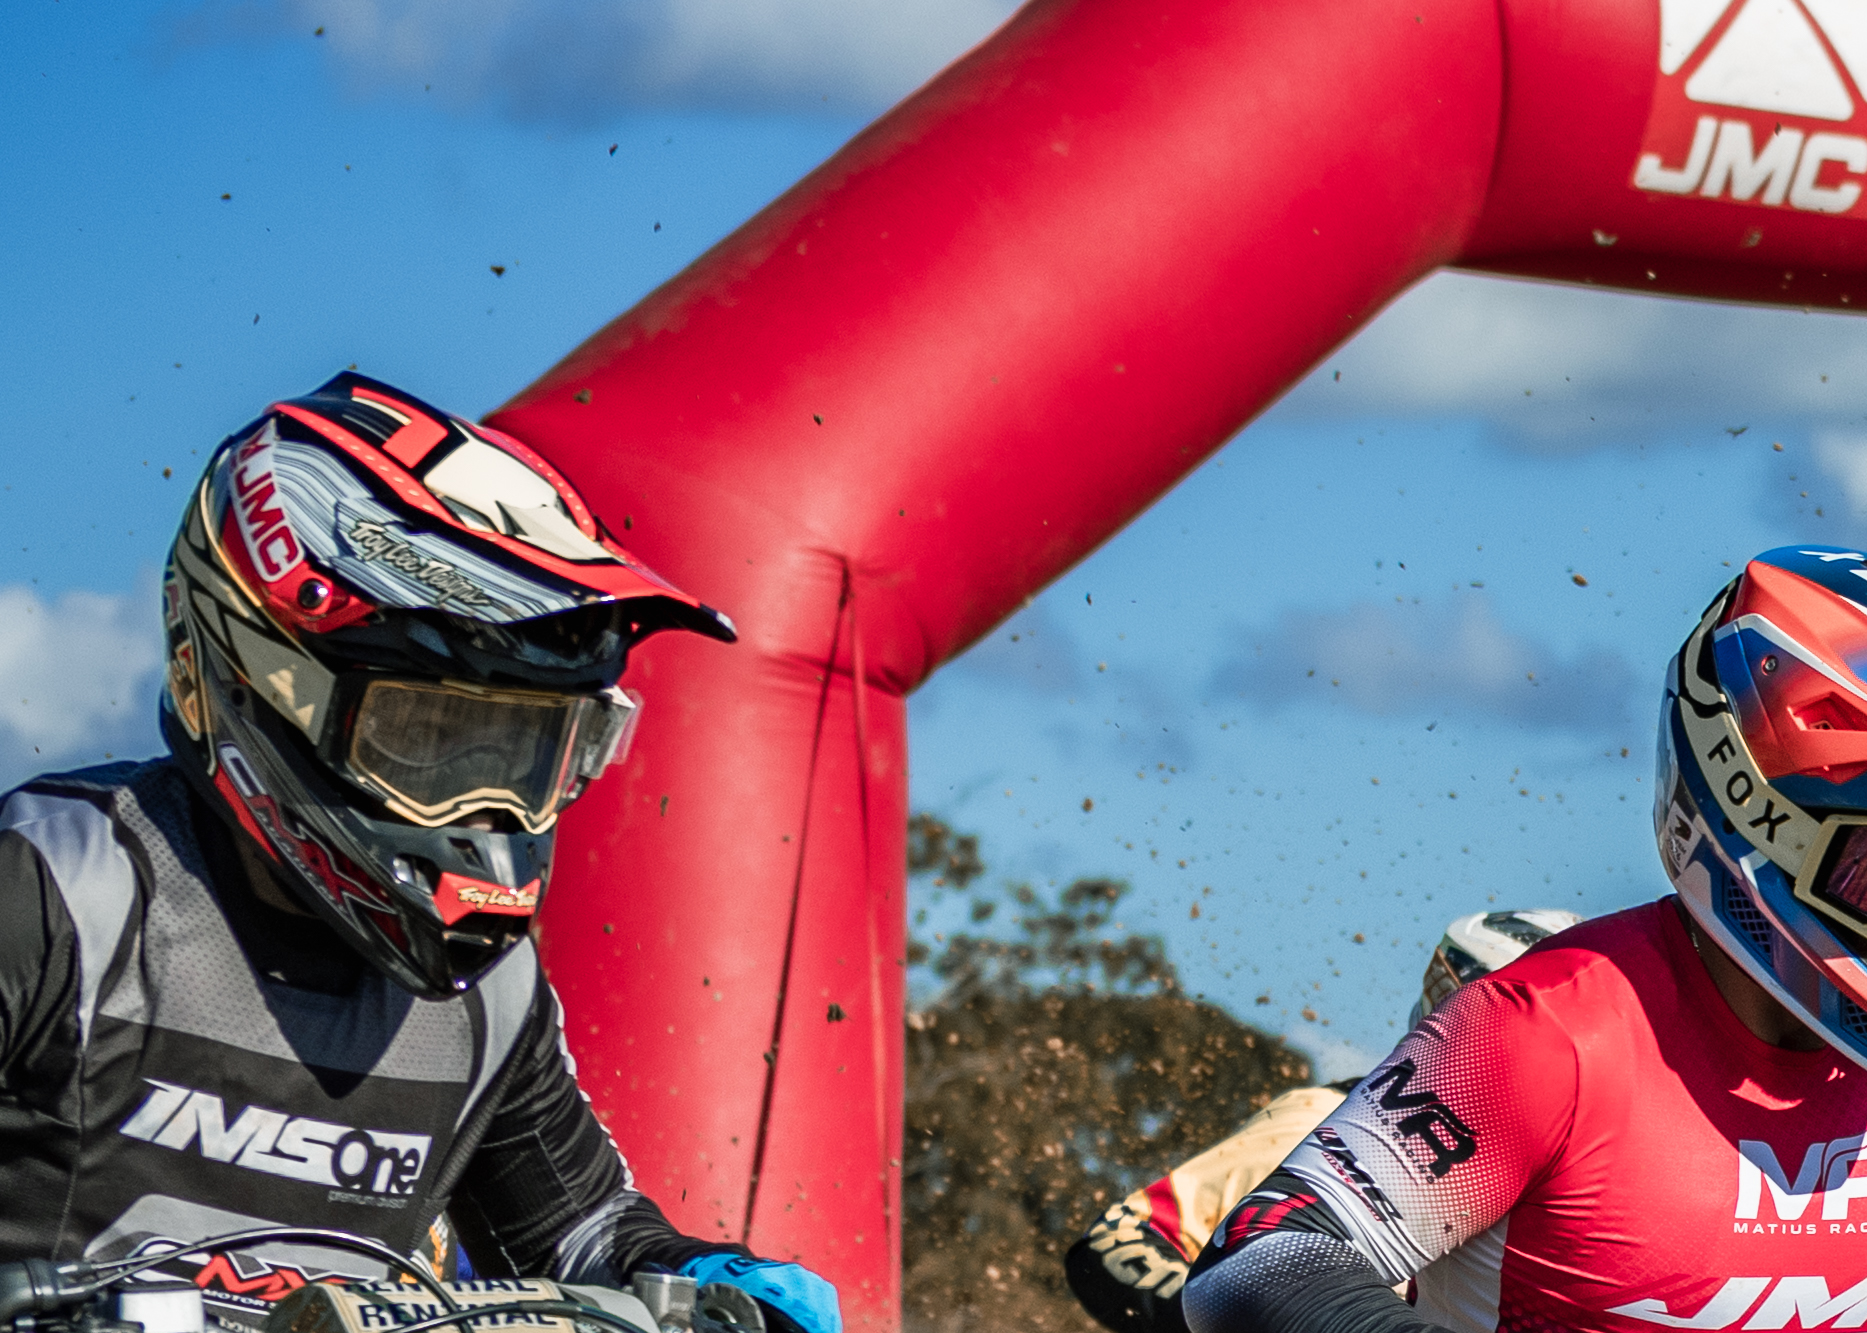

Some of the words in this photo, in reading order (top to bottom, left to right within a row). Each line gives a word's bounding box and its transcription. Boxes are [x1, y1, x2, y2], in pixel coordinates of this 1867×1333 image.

[231, 460, 304, 583] JMC
[1705, 732, 1792, 846] FOX
[1732, 1221, 1818, 1236] MATIUS
